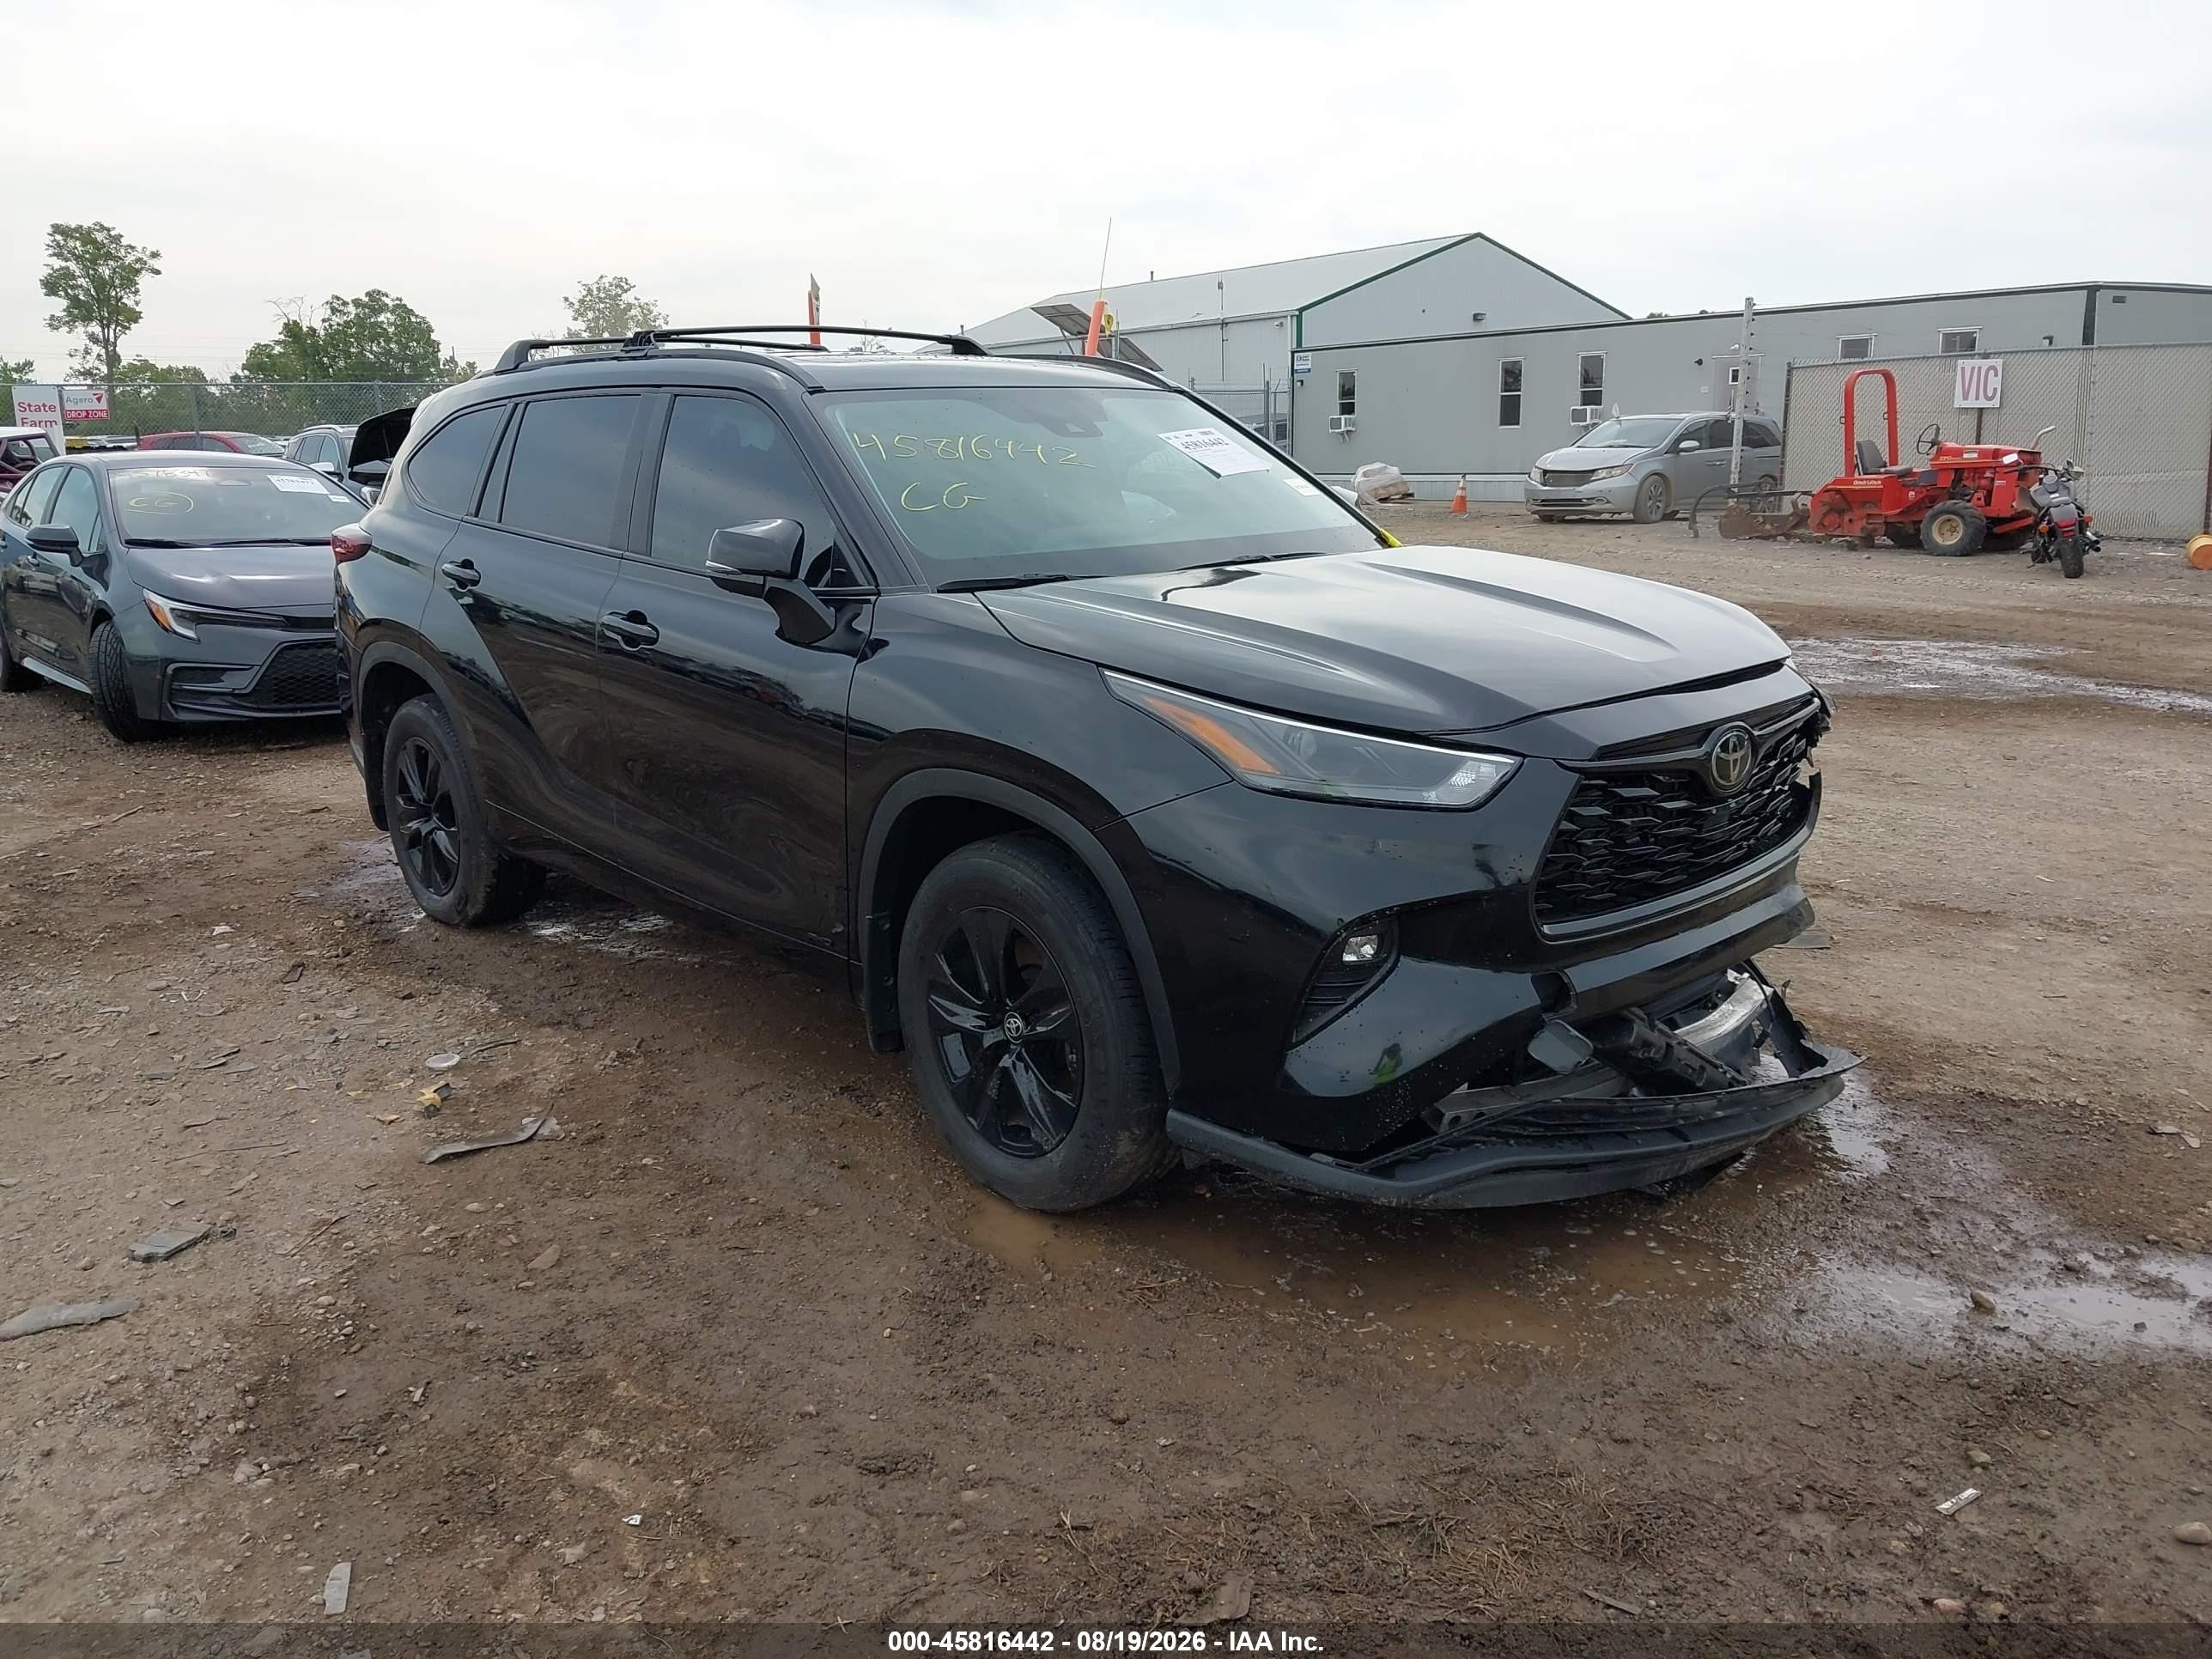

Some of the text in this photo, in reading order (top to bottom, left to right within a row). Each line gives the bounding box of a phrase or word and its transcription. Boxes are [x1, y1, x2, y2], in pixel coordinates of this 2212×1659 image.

[1960, 365, 1998, 401] VIC
[65, 396, 94, 405] Agero
[17, 401, 57, 413] State
[66, 410, 108, 419] DROP ZONE
[20, 417, 58, 428] Farm
[853, 431, 1097, 469] 45816442
[900, 481, 988, 513] CG
